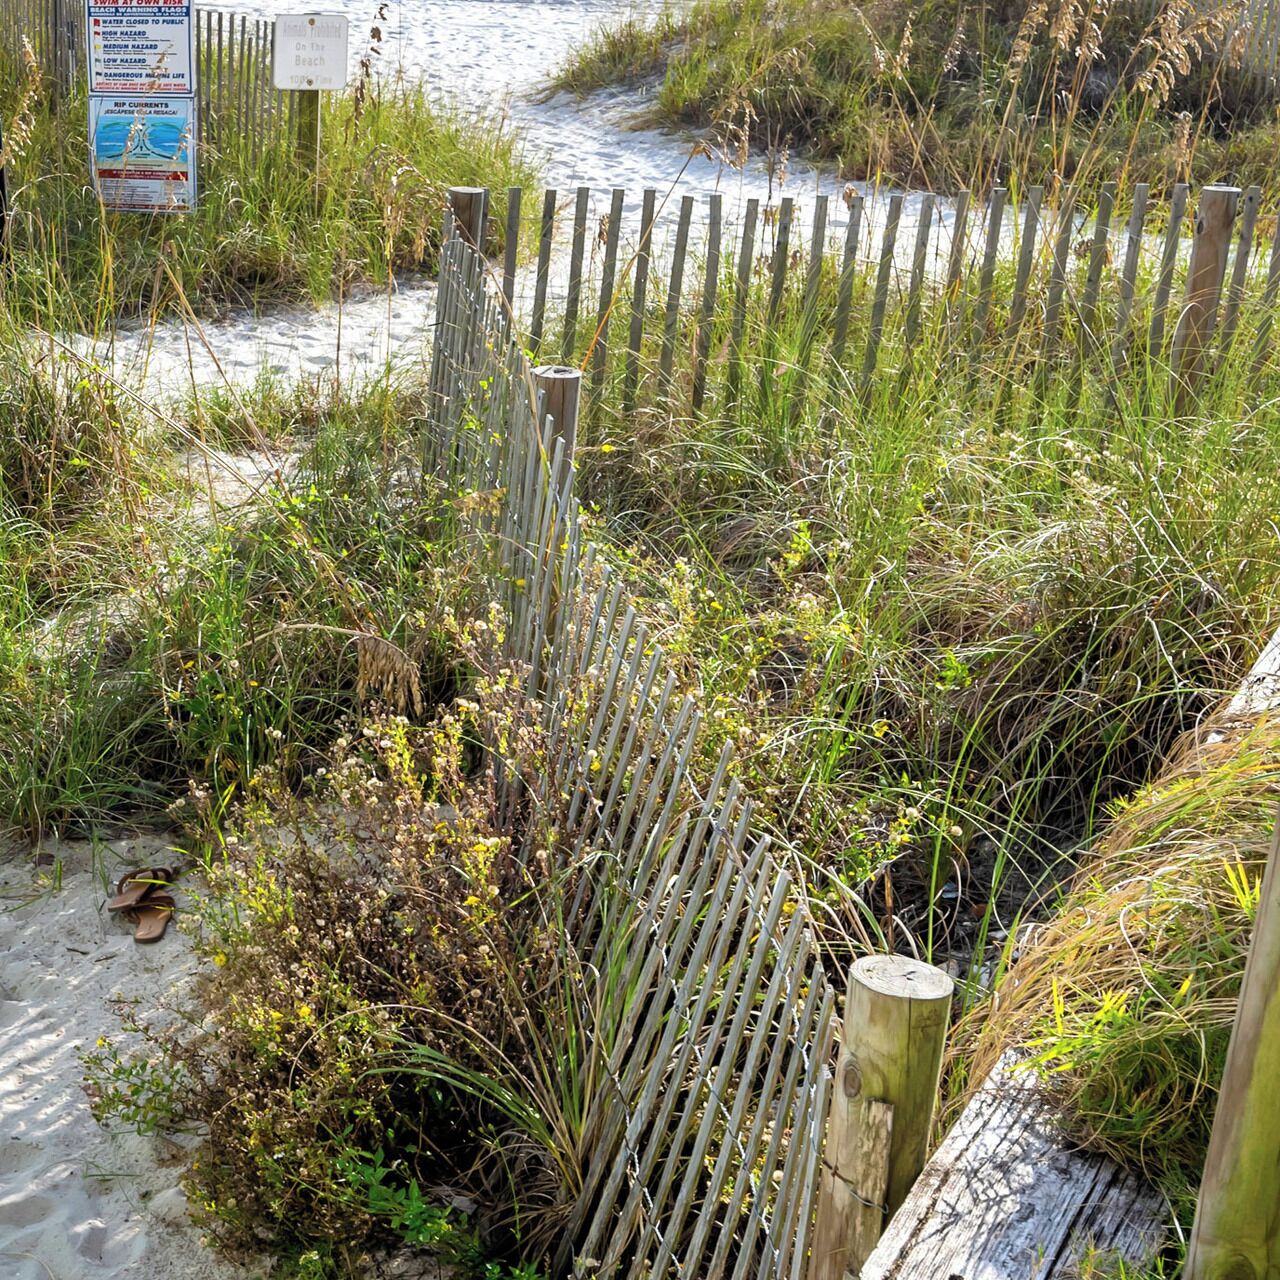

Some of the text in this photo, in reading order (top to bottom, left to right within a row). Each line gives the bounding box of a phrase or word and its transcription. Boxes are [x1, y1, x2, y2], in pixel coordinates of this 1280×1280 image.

[295, 42, 326, 51] On The
[295, 54, 325, 66] Beach
